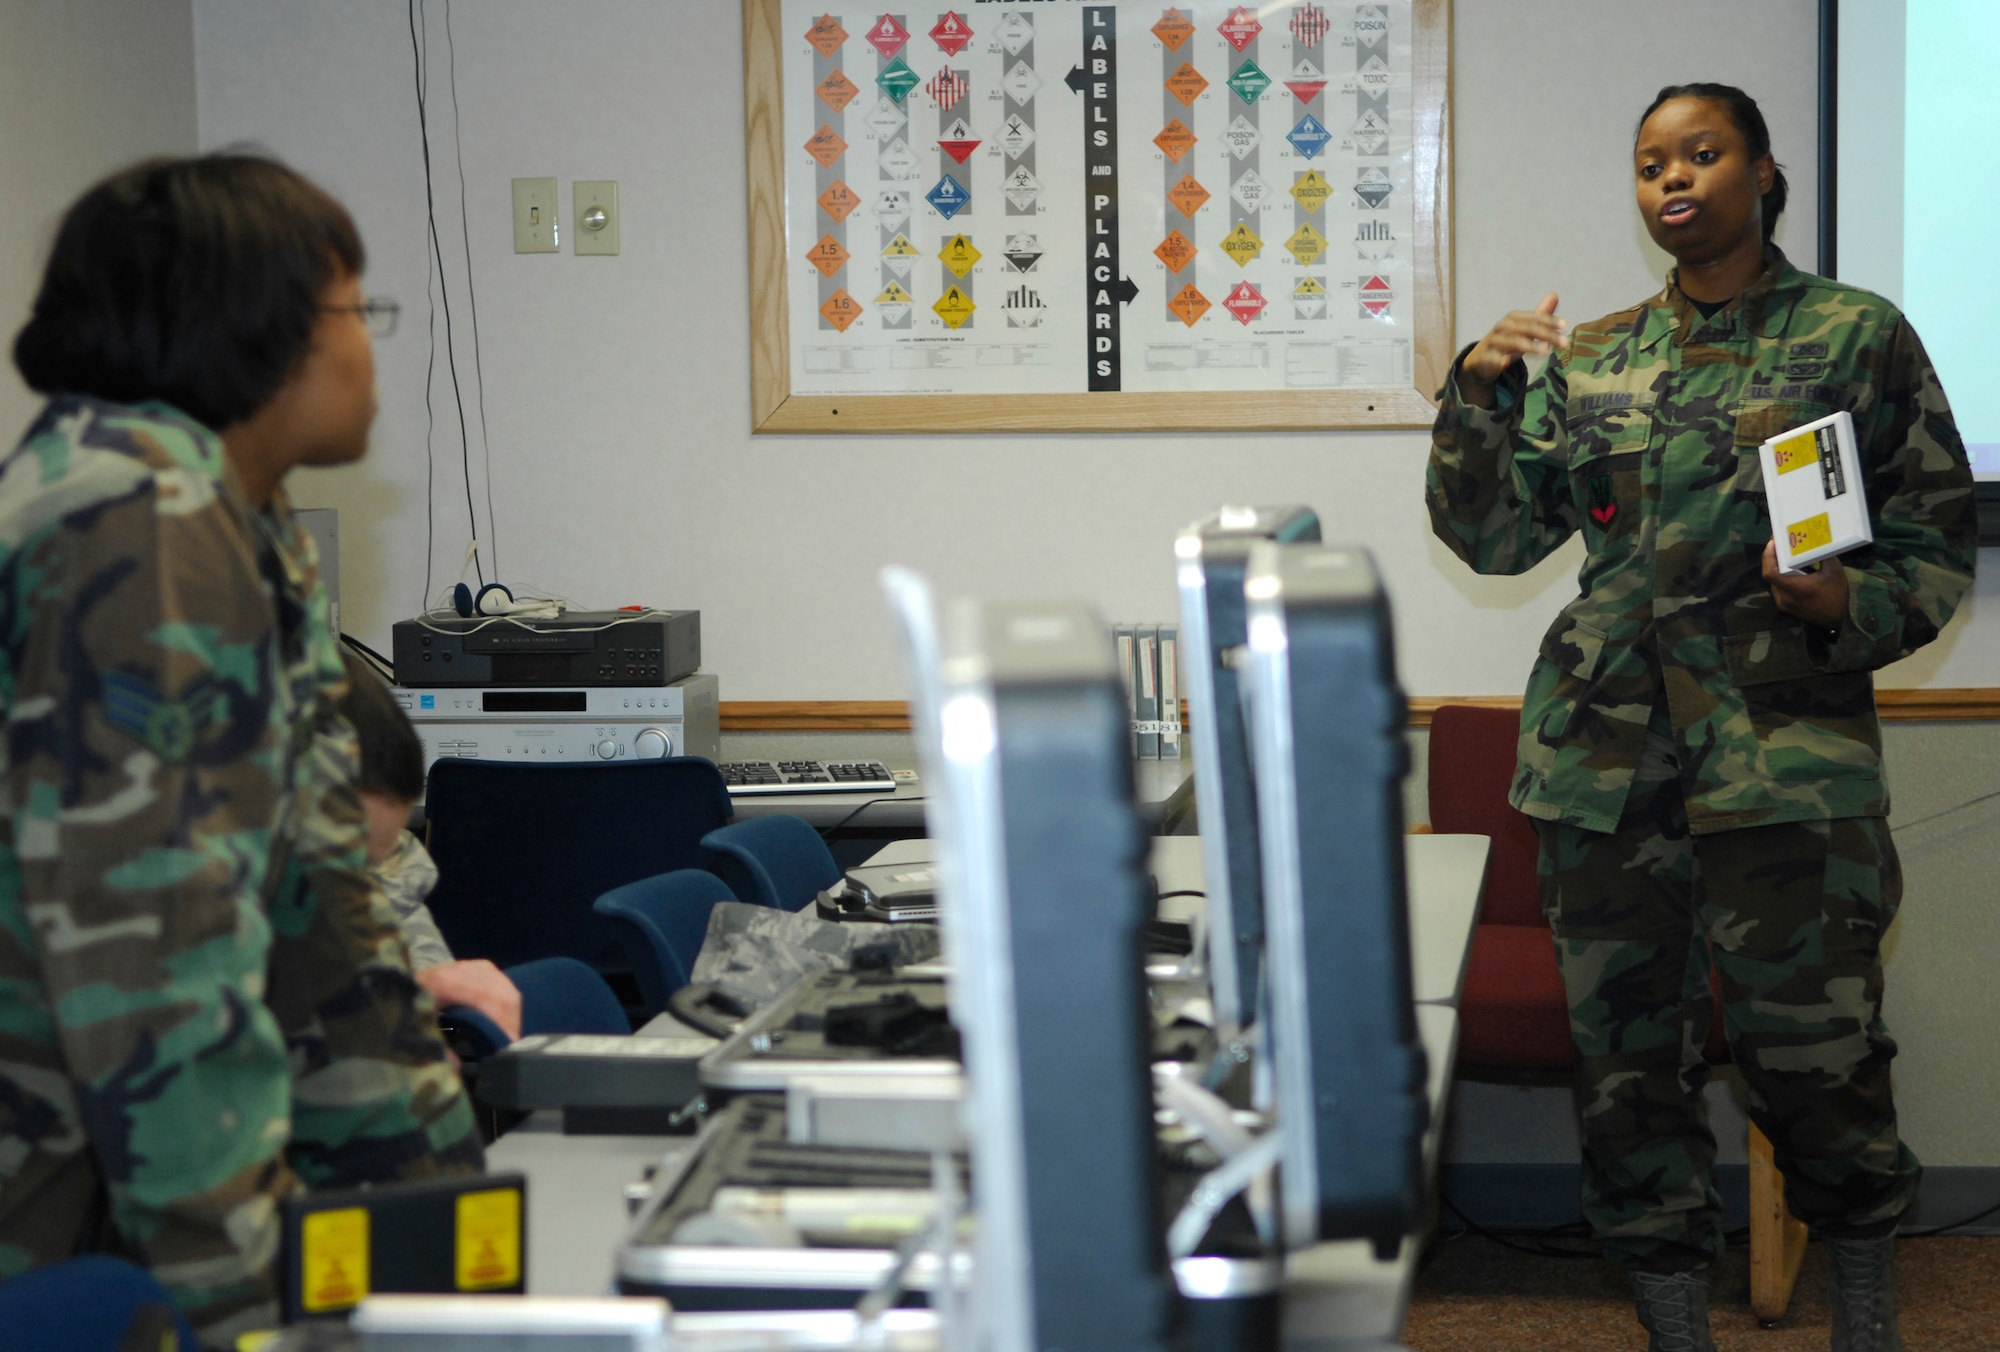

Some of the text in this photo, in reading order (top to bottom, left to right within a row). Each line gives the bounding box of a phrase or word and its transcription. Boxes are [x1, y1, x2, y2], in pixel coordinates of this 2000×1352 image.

[1354, 21, 1386, 31] POISON
[1092, 11, 1107, 146] LABELS
[1362, 74, 1388, 84] TOXIC
[1226, 131, 1255, 139] POISON
[1233, 138, 1250, 146] GAS
[1092, 166, 1112, 175] AND
[1181, 182, 1194, 190] 1.4
[831, 189, 847, 200] 1.4
[1243, 192, 1260, 200] GAS
[1296, 188, 1328, 197] OXIDIZER
[1169, 237, 1182, 246] 1.5
[820, 243, 837, 255] 1.5
[1226, 242, 1256, 251] OXYGEN
[1094, 195, 1112, 376] PLACARDS
[1183, 290, 1195, 299] 1.6
[832, 298, 850, 309] 1.6
[1228, 299, 1262, 307] FLAMMABLE
[1752, 384, 1842, 400] U.S. AIR FOR
[1580, 392, 1633, 411] WILLIAMS
